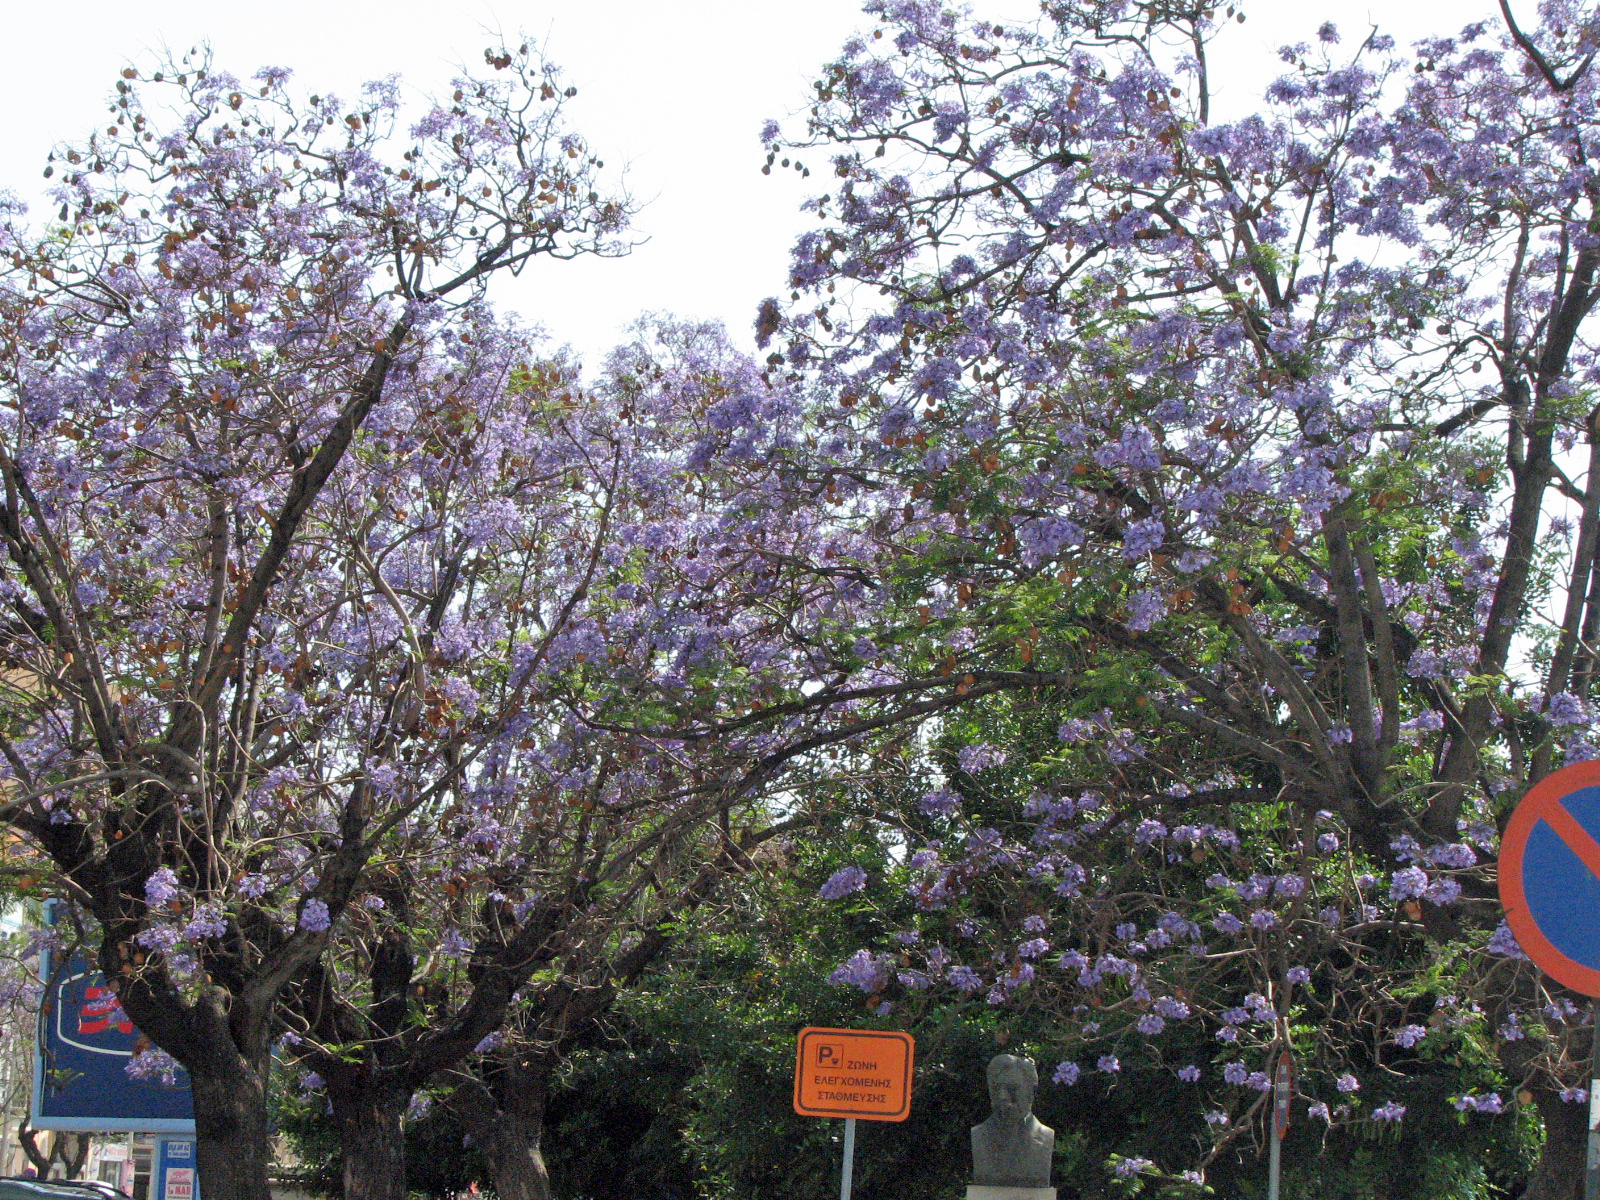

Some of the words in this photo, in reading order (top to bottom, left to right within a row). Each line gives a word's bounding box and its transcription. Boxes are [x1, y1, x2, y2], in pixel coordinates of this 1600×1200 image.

[818, 1046, 833, 1063] P
[847, 1060, 877, 1070] ΖΩΝΗ
[814, 1075, 892, 1089] ΕΛΕΓΧΟΜΕΝΗΣ
[817, 1091, 887, 1103] ΣΤΑΘΜΕΥΣΗΣ
